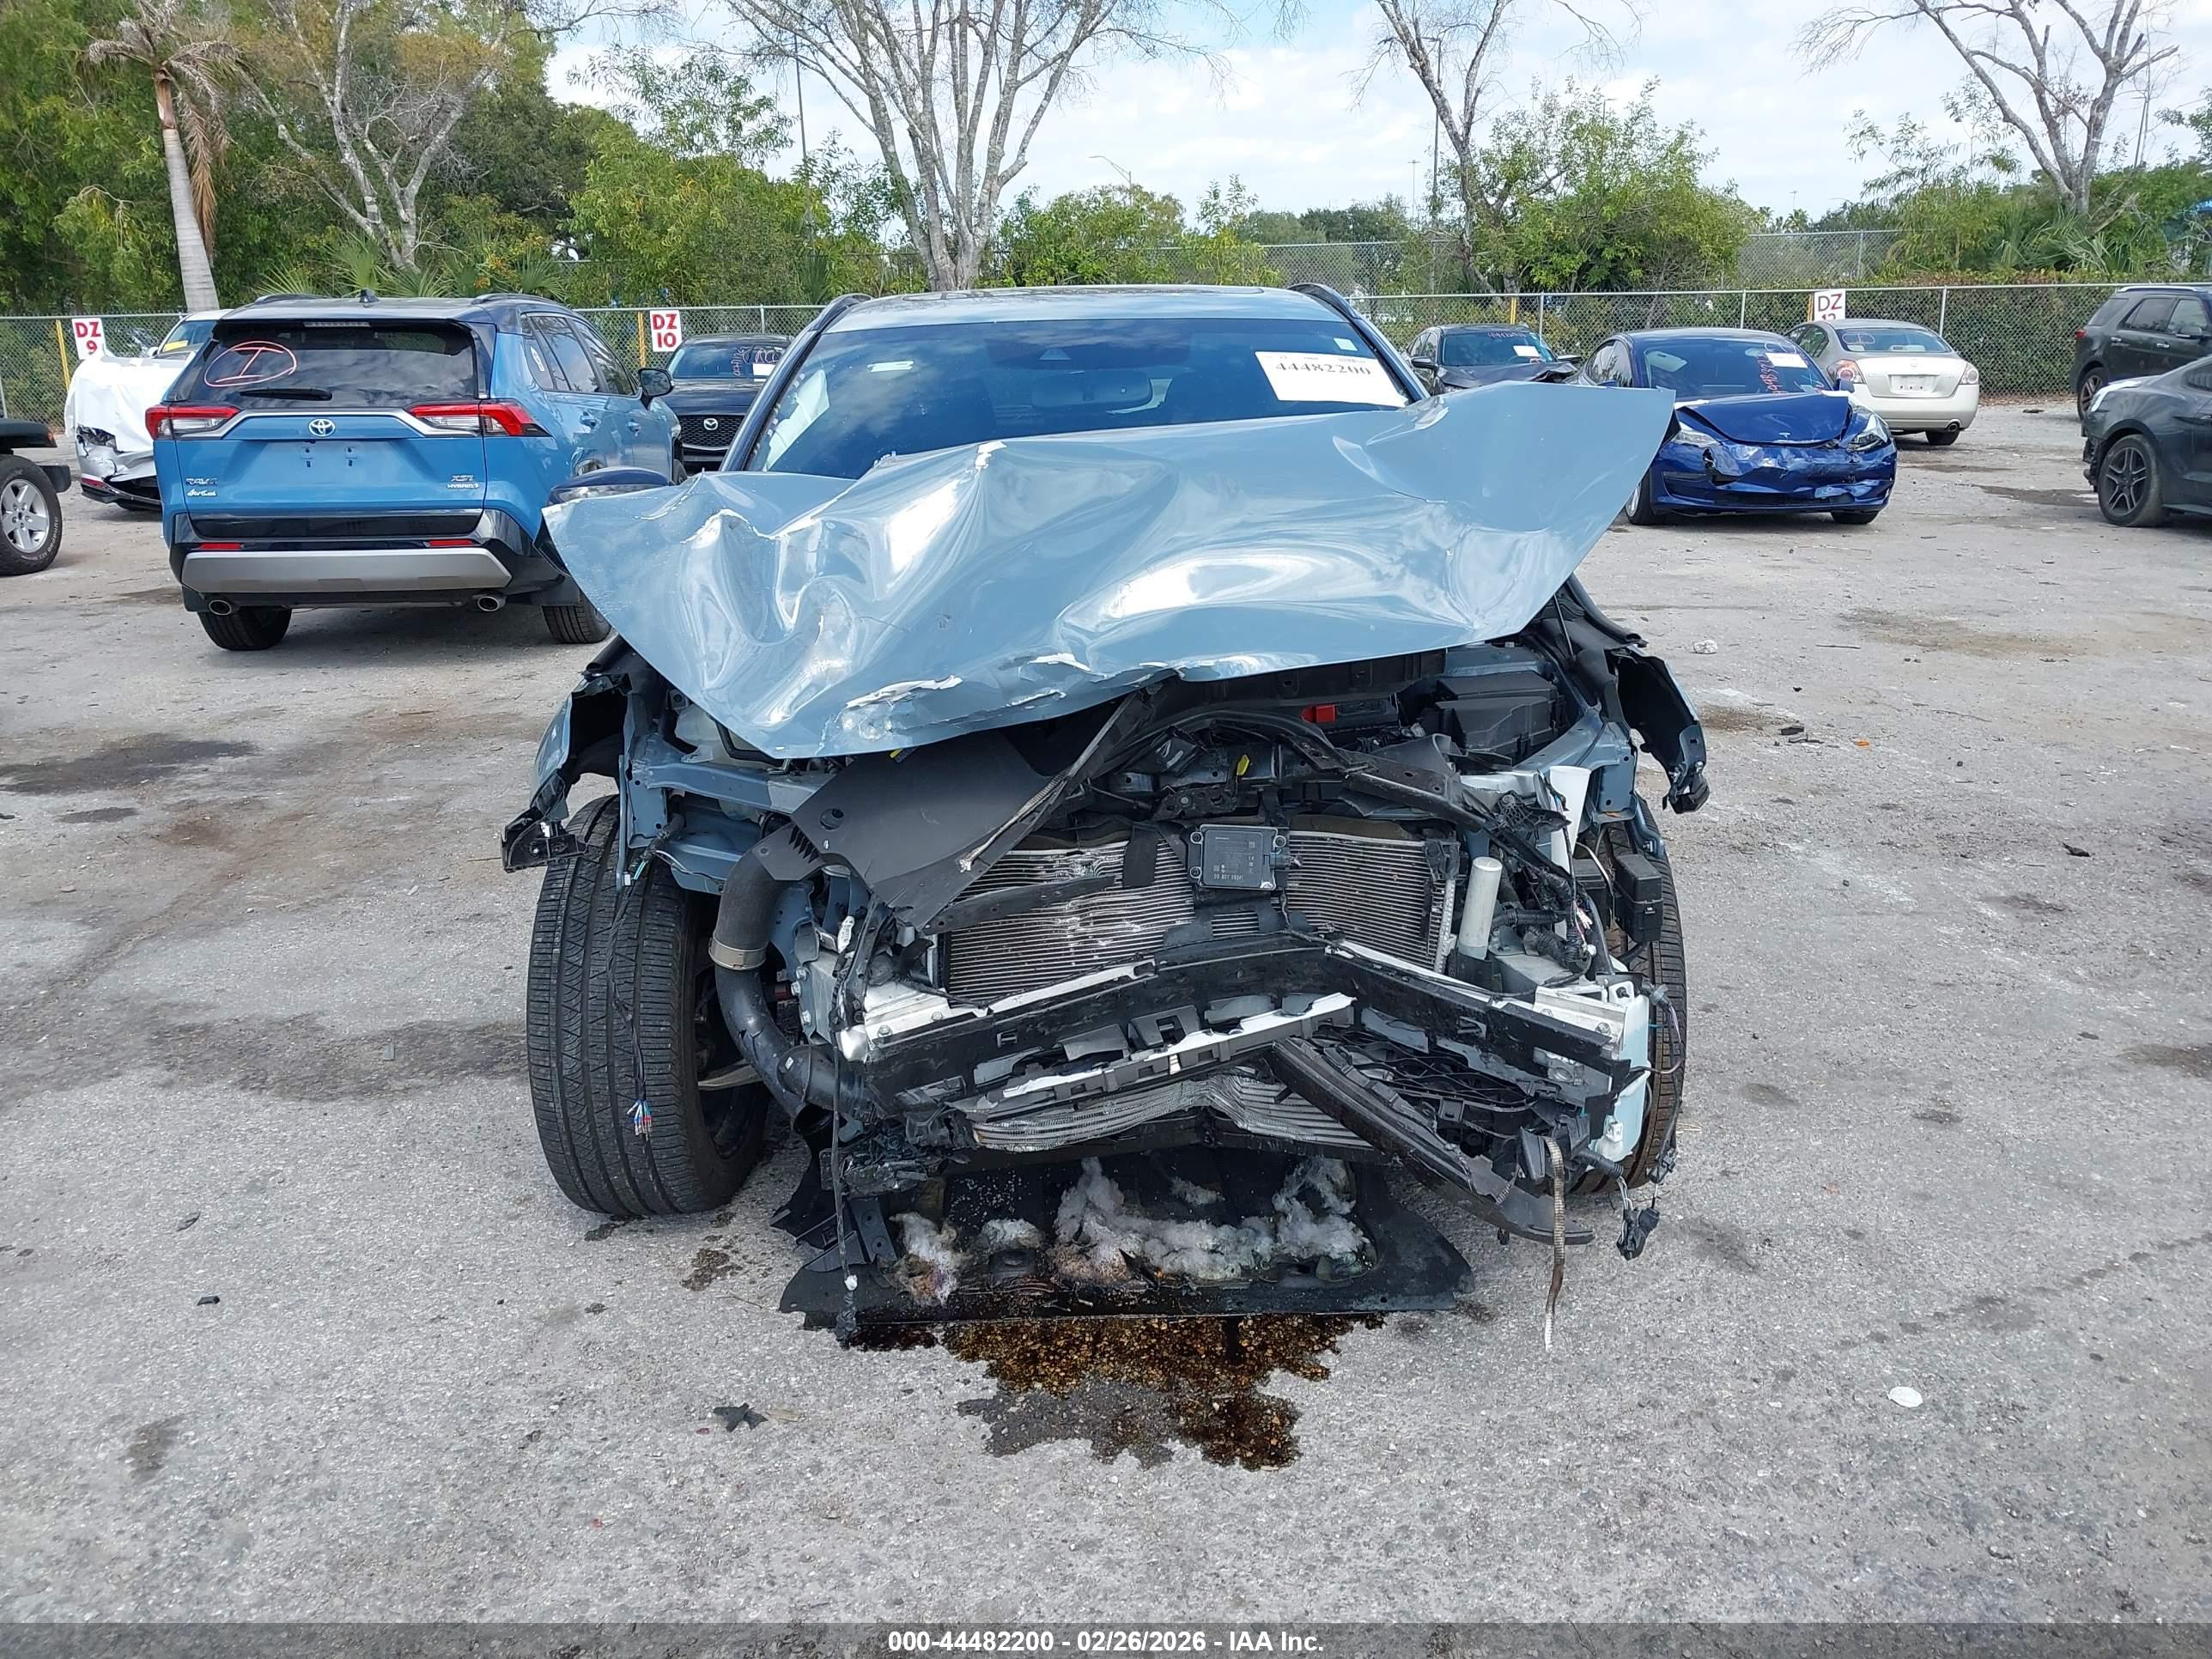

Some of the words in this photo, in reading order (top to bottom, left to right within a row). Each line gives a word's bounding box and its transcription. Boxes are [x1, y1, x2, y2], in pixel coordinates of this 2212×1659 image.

[1818, 293, 1842, 312] DZ
[75, 321, 100, 337] DZ
[652, 313, 678, 330] DZ
[86, 340, 97, 355] 9
[657, 332, 677, 348] 10
[1275, 362, 1371, 375] 44482200
